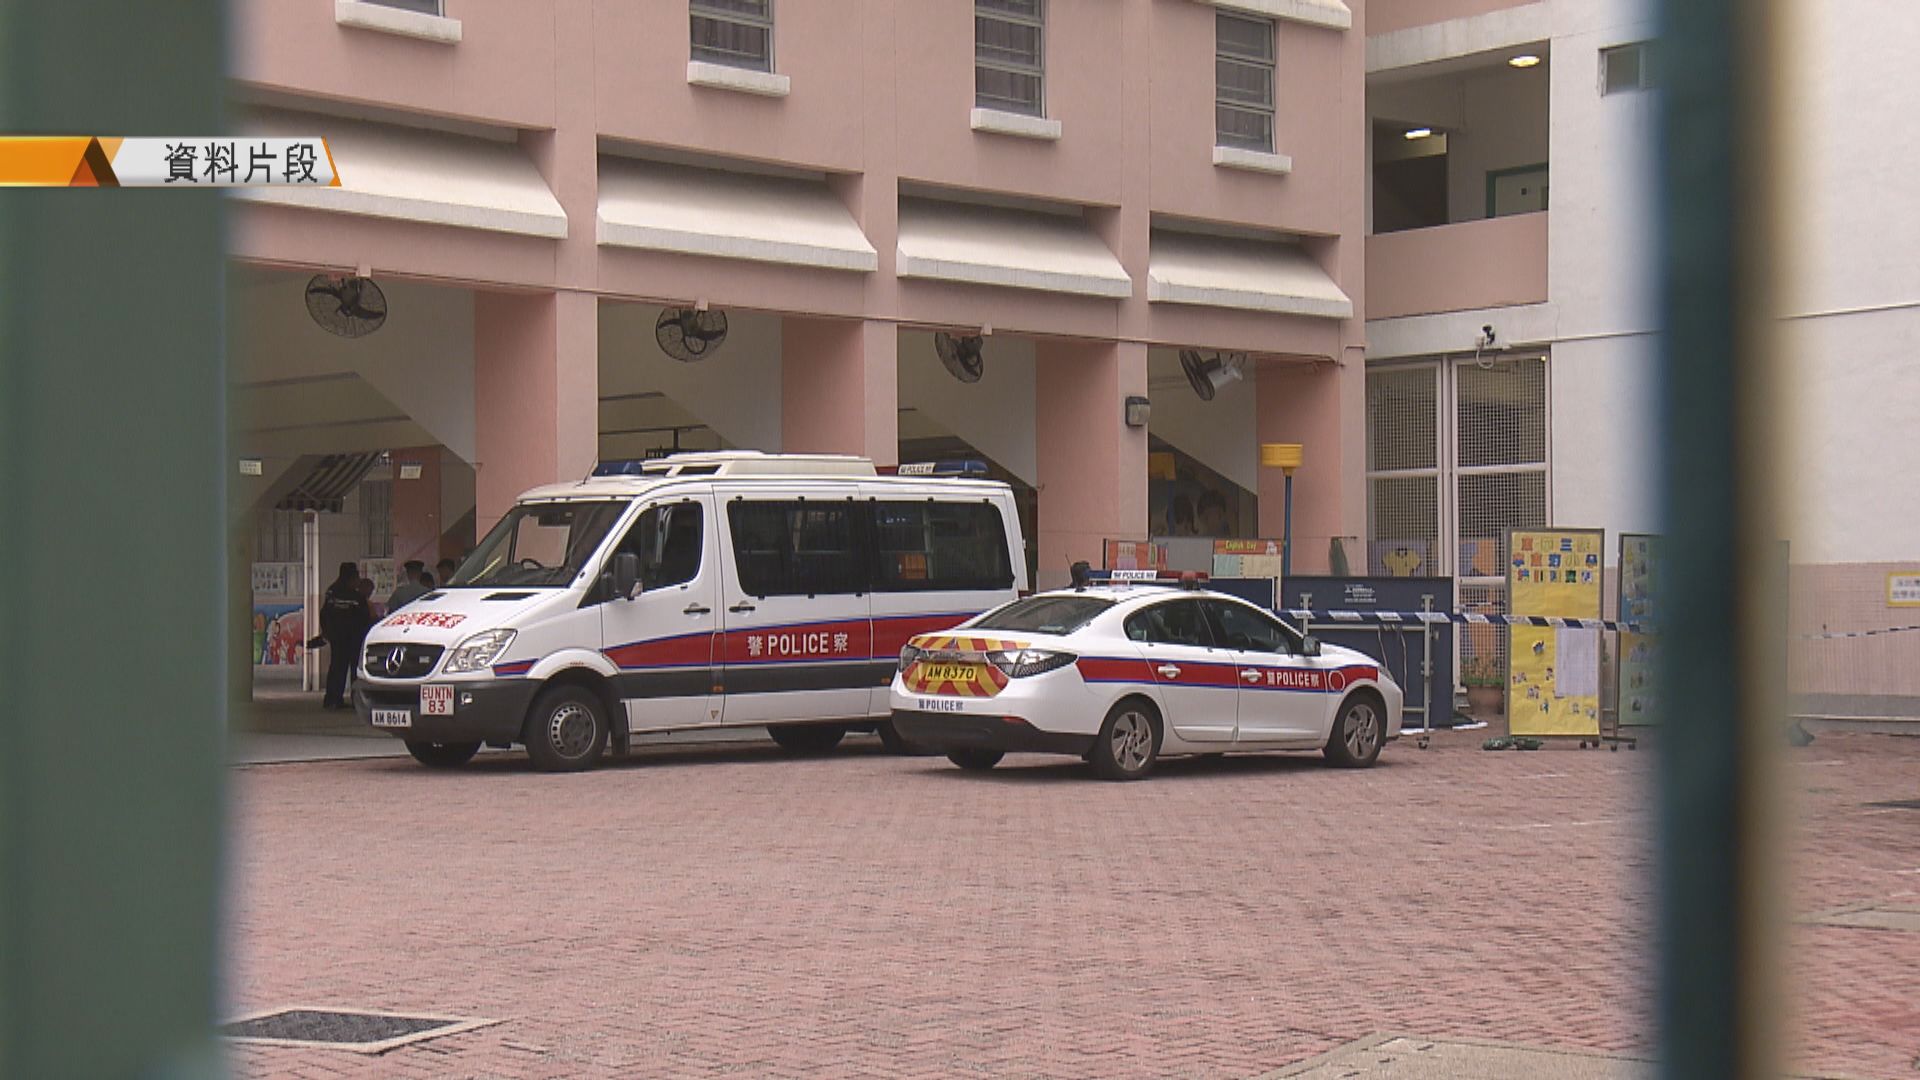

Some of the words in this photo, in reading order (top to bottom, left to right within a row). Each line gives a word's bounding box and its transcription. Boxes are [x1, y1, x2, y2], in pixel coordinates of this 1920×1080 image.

[747, 635, 763, 657] 警
[767, 633, 829, 655] POLICE
[833, 632, 848, 652] 察
[928, 667, 941, 679] AM
[943, 667, 974, 679] 8370
[1276, 672, 1310, 687] POLICE
[428, 700, 446, 714] 83
[926, 700, 955, 711] POLICE
[387, 712, 408, 725] 8614
